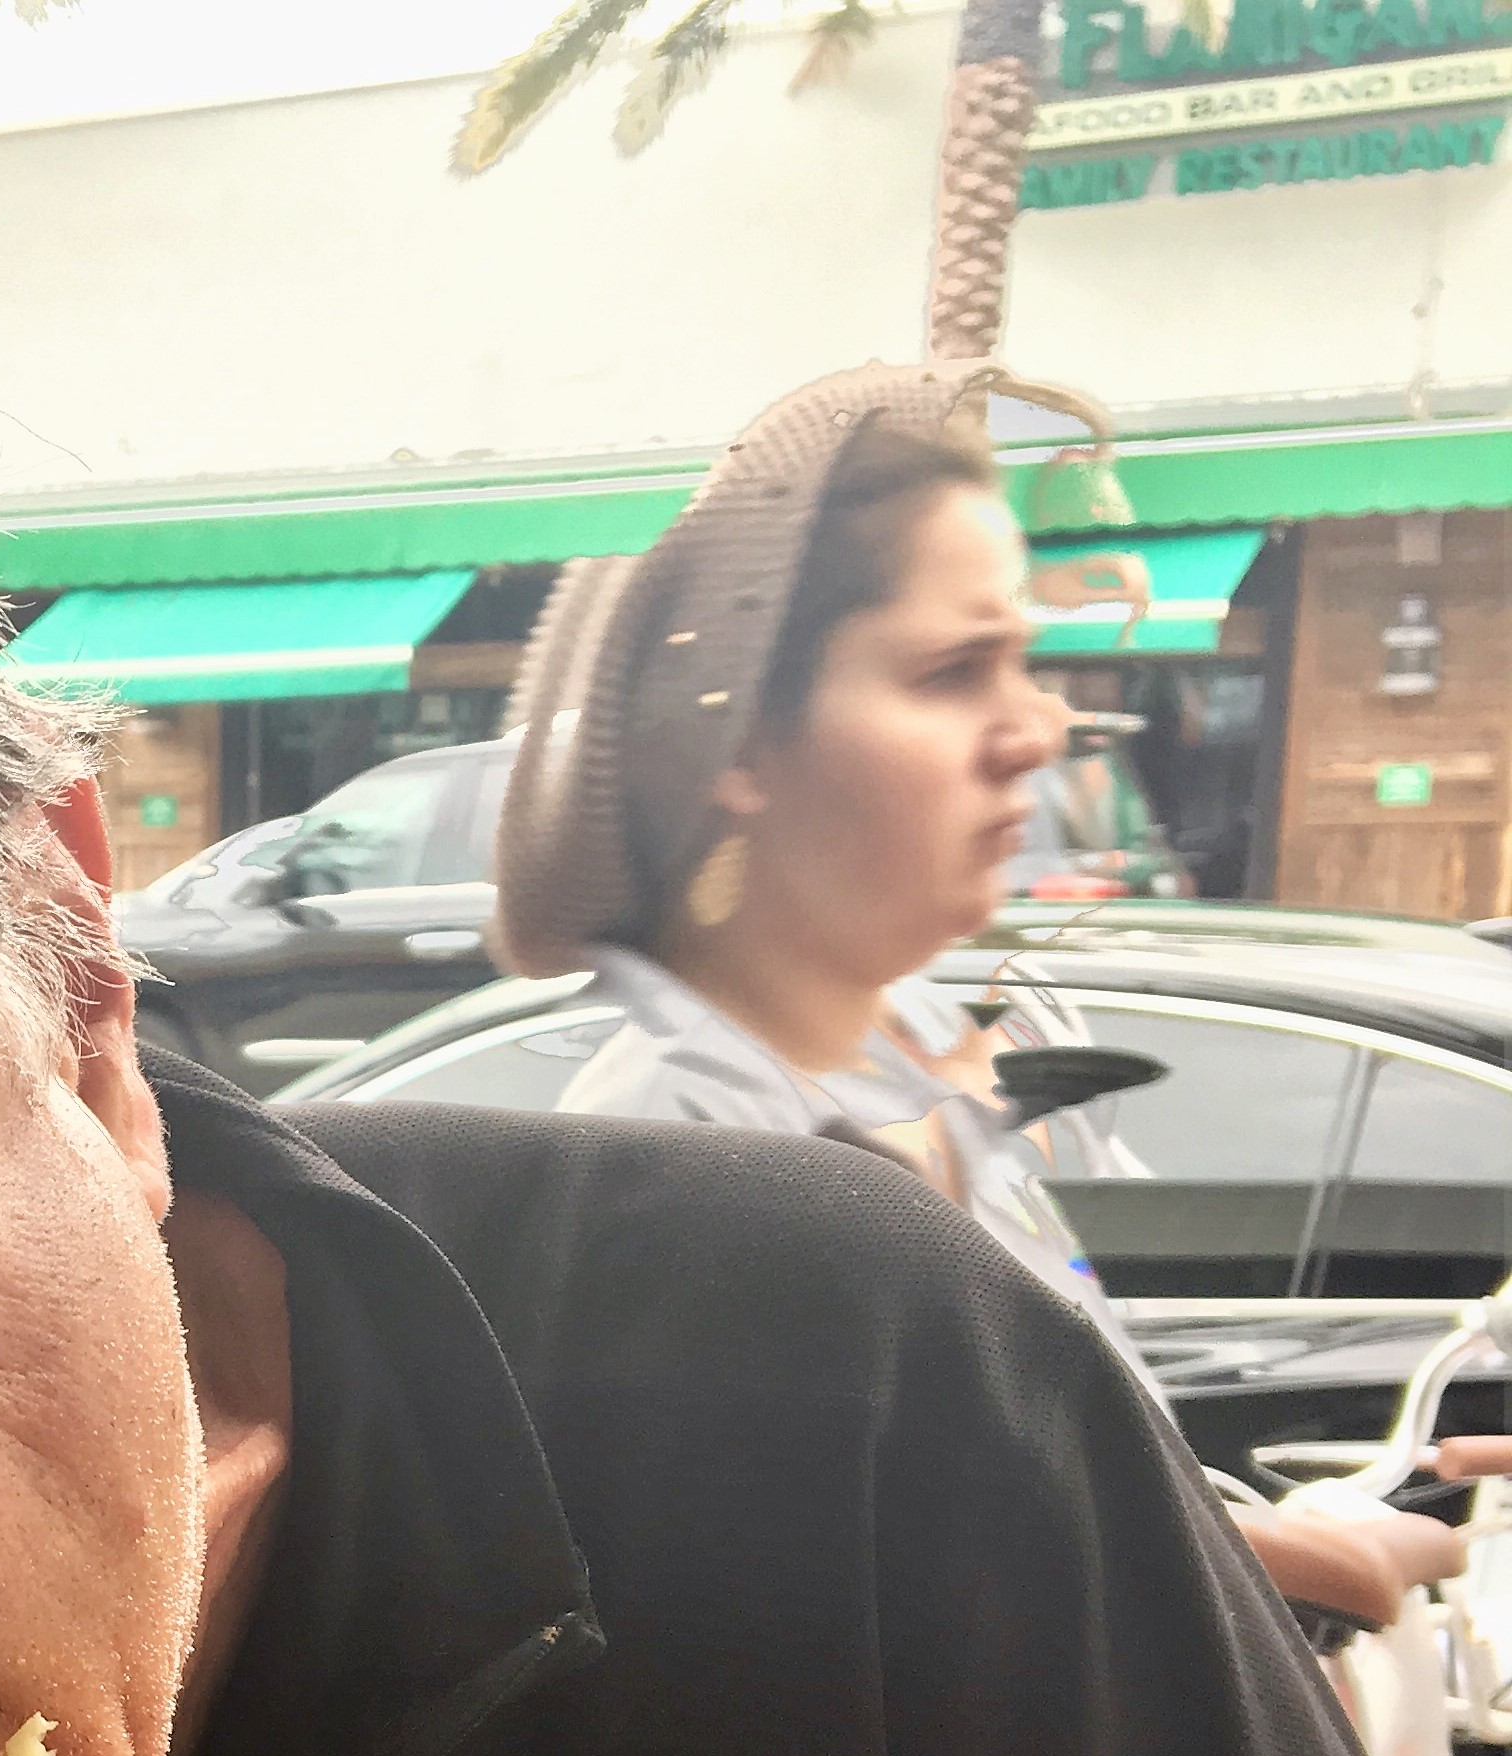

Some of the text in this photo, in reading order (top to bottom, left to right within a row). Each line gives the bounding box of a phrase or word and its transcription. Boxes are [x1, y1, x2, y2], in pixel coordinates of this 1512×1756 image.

[1060, 0, 1512, 88] FLANIGAN
[1187, 87, 1279, 122] BAR
[1298, 72, 1393, 107] AND
[1407, 61, 1512, 96] GRIL
[1017, 114, 1505, 211] AMILY RESTAURANT
